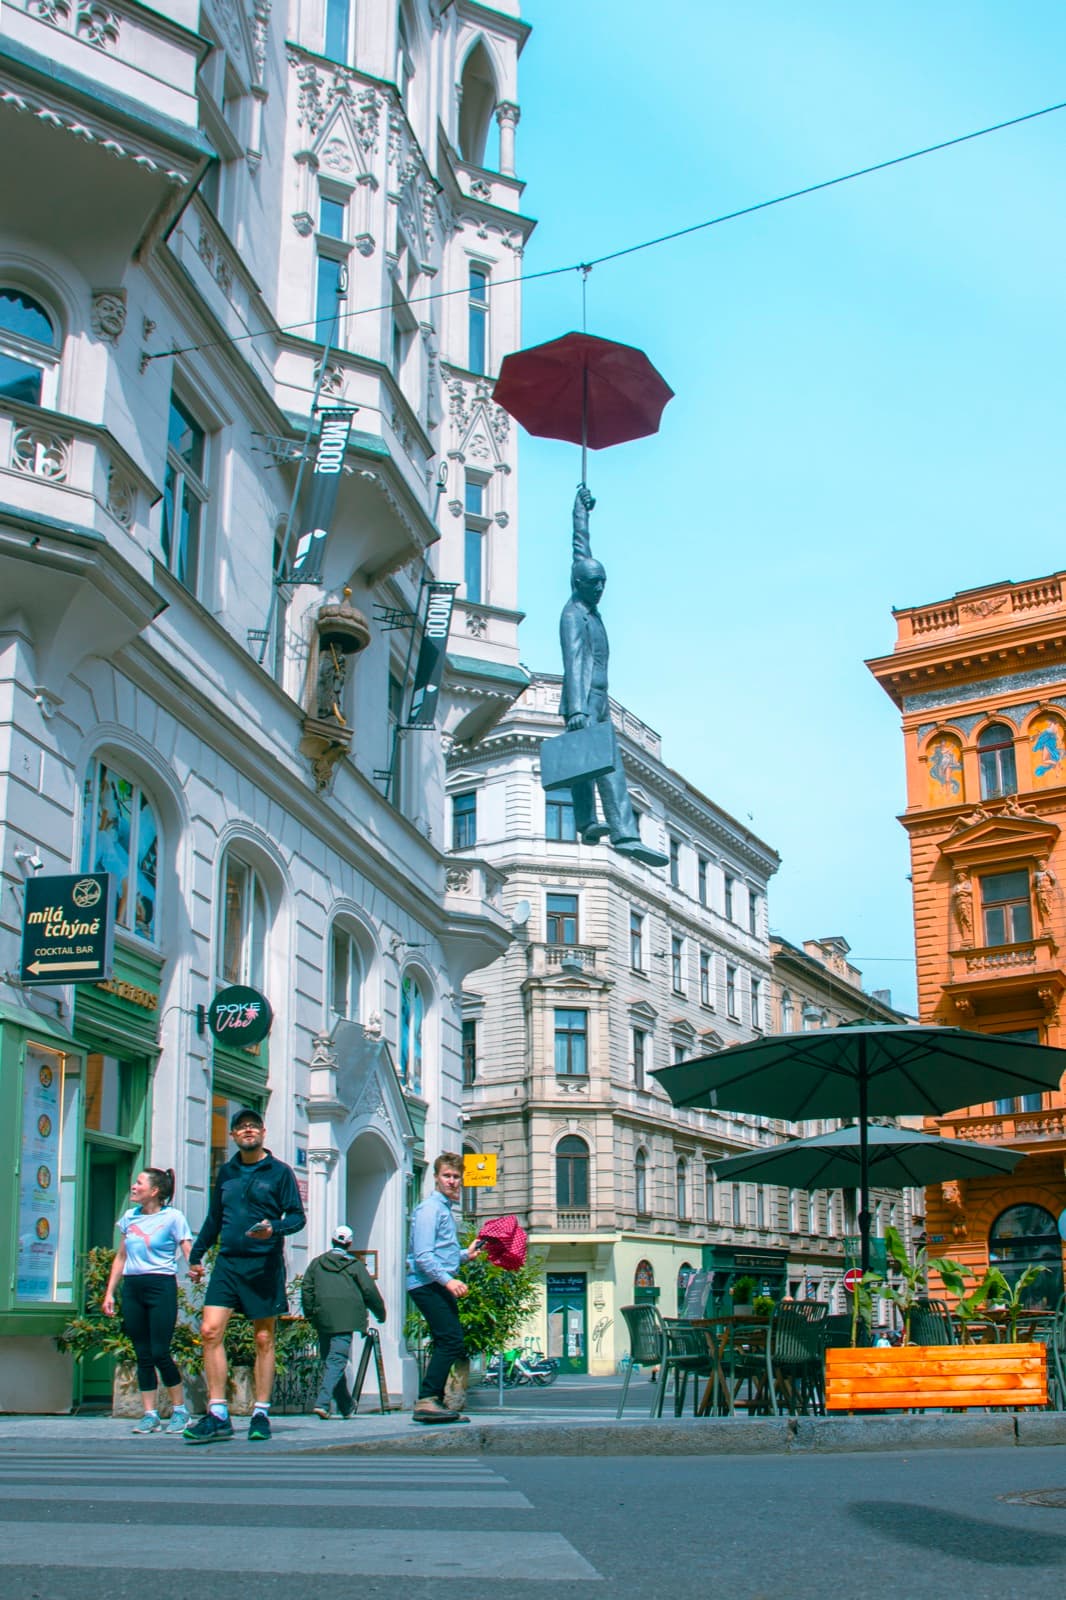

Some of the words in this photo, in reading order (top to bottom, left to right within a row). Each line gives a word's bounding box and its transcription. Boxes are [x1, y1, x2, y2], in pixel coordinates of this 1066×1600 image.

[27, 906, 63, 924] milá
[44, 918, 100, 939] tchýně
[34, 947, 74, 957] COCKTAIL
[76, 945, 94, 954] BAR
[216, 1002, 261, 1014] POKE
[216, 1010, 253, 1032] Vibe
